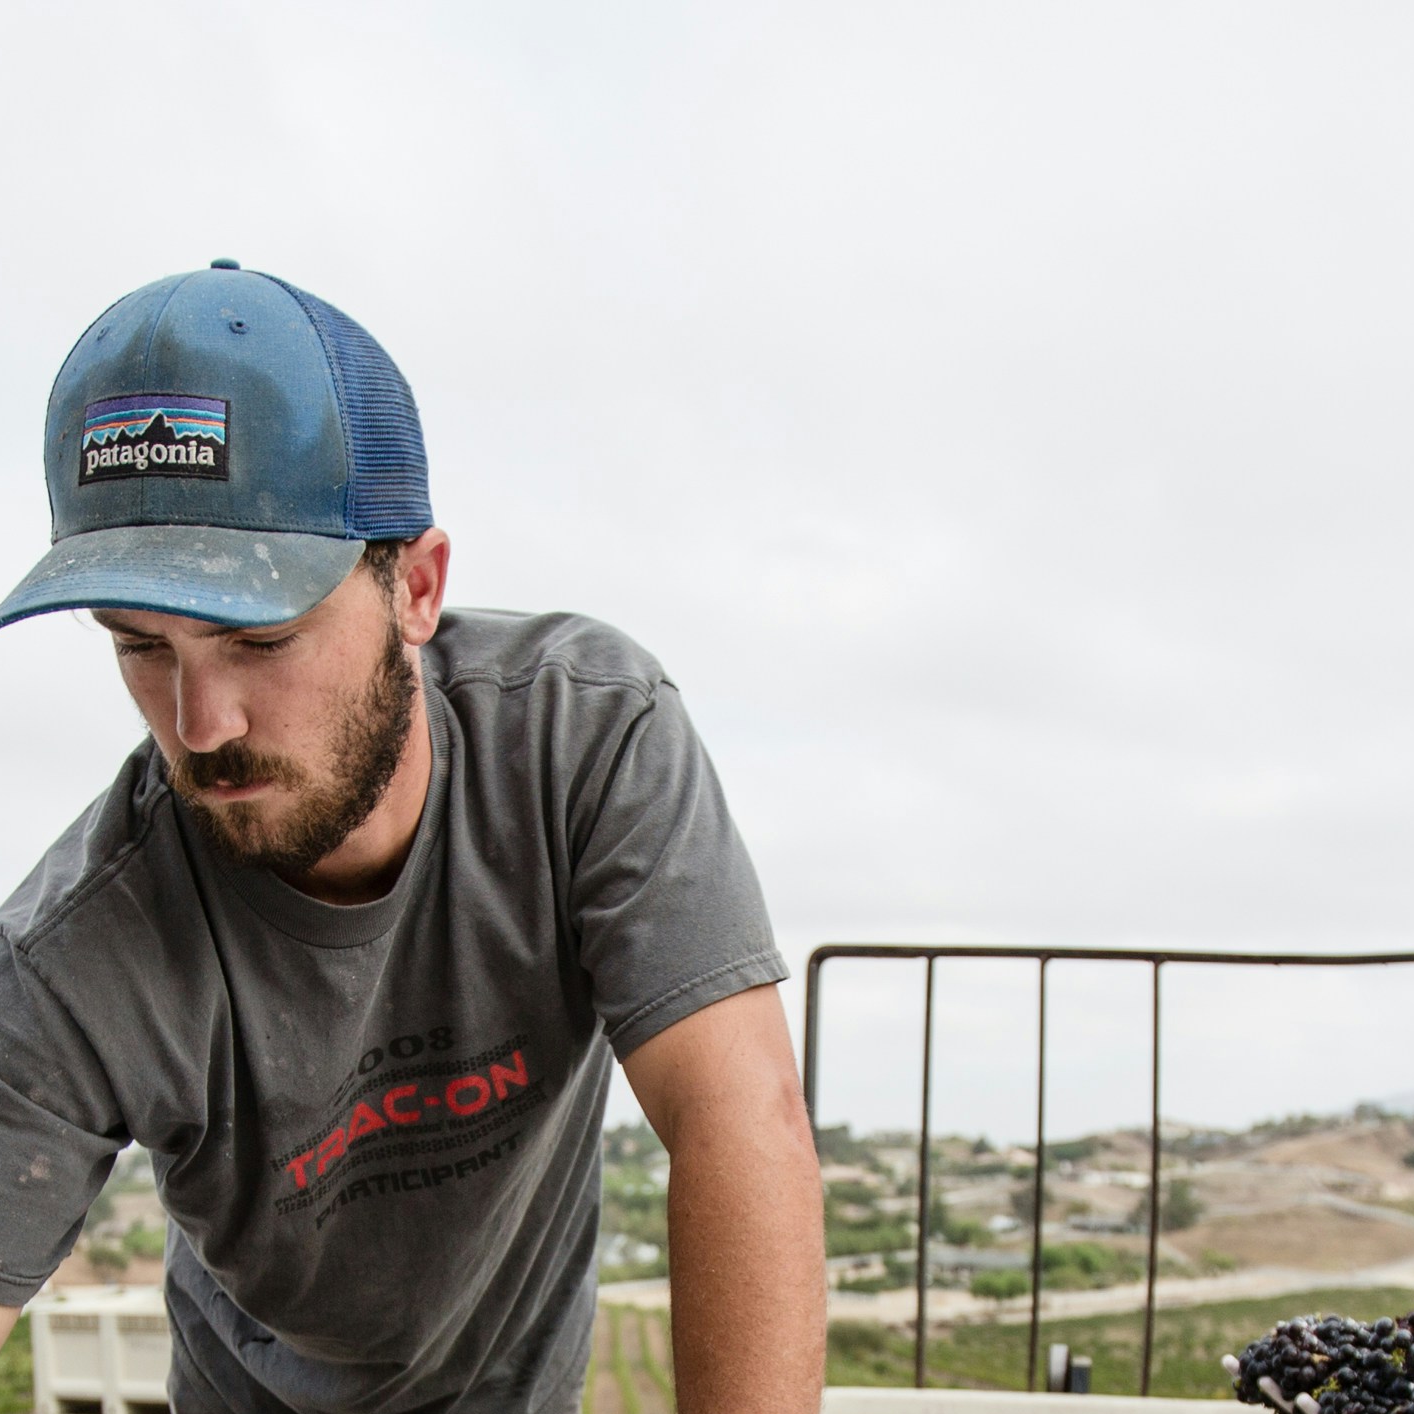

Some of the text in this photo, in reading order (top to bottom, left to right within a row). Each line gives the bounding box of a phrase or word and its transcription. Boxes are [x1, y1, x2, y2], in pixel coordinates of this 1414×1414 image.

[85, 439, 216, 476] patagonia
[285, 1049, 529, 1190] TRAC-ON
[315, 1131, 521, 1230] PARTICIPANT
